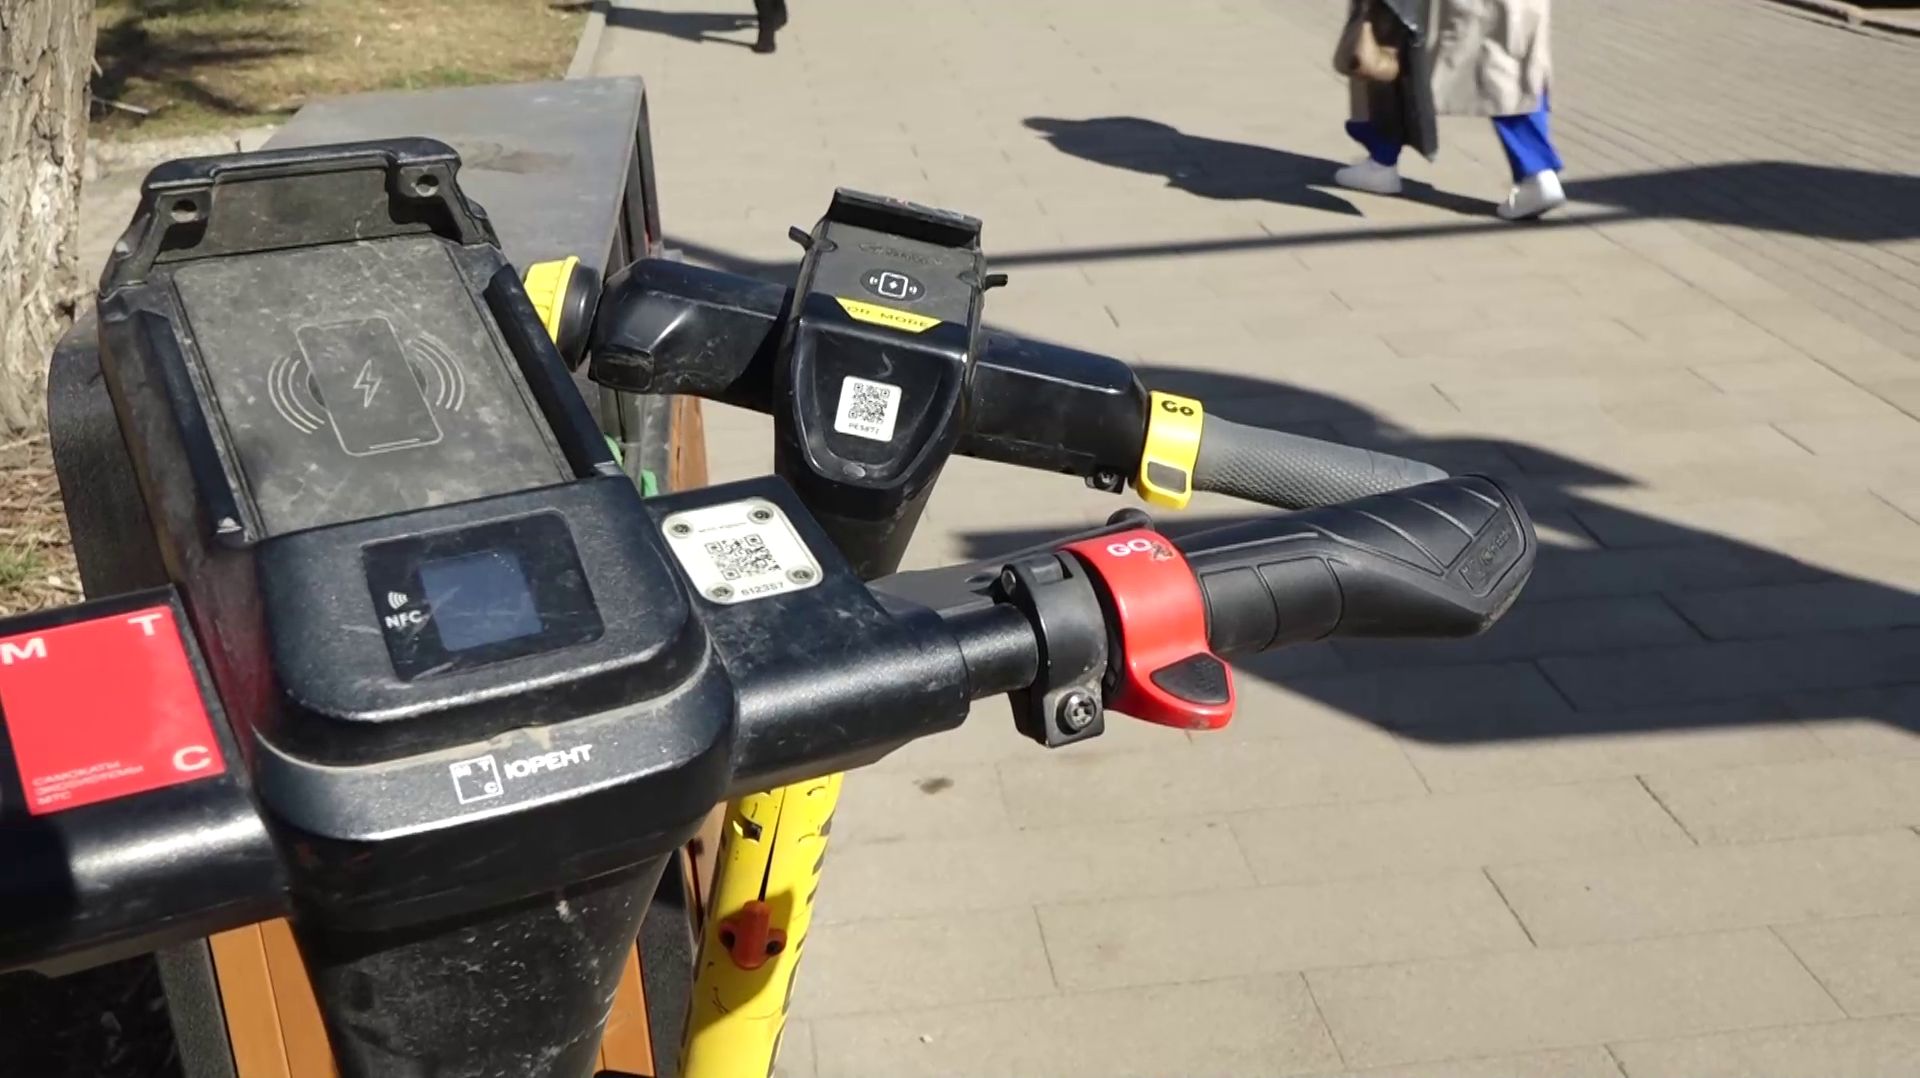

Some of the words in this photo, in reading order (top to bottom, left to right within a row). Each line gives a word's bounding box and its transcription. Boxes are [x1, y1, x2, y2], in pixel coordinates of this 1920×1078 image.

[880, 312, 929, 327] MORE
[384, 610, 422, 629] NFC
[504, 744, 592, 779] ЮРЕНТ
